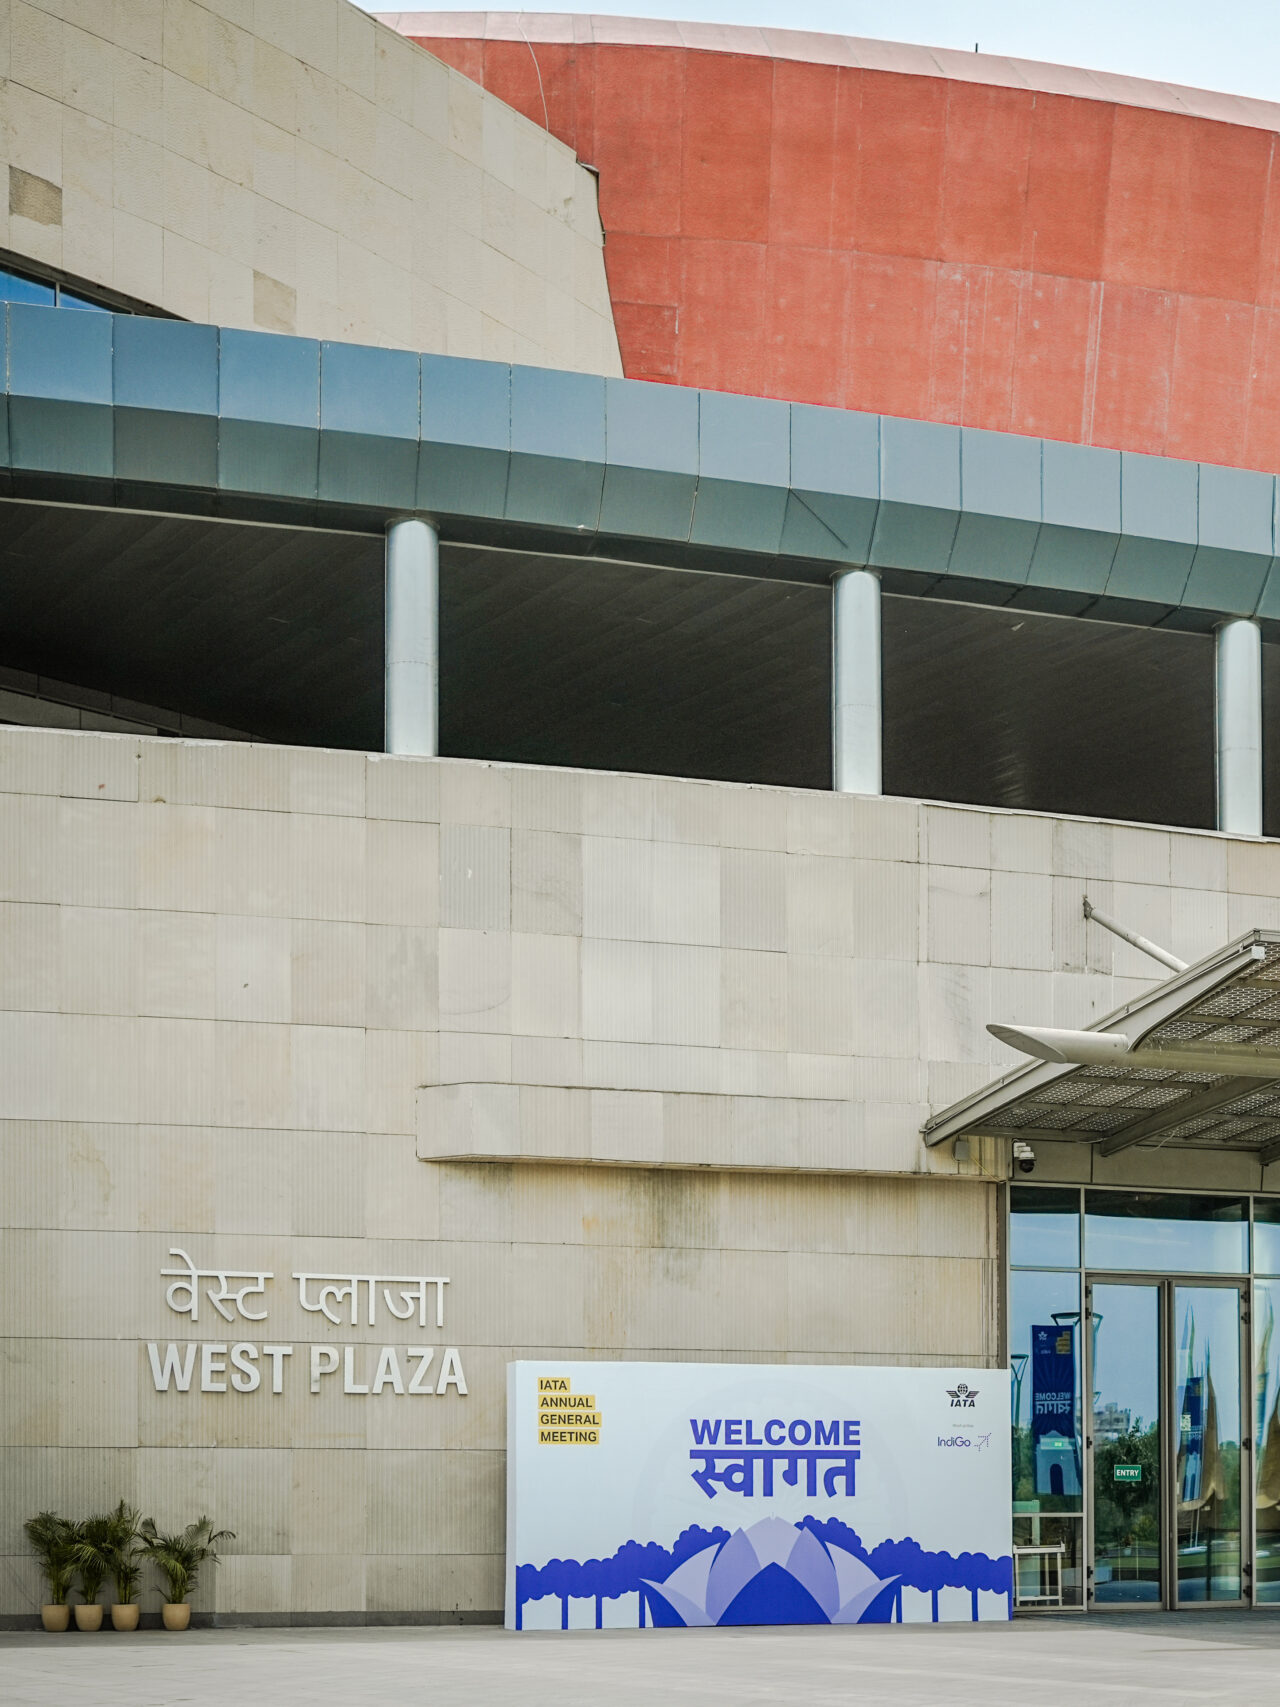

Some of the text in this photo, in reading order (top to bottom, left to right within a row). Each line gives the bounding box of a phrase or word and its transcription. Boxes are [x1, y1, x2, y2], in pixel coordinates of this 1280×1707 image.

[160, 1248, 451, 1328] वेस्ट प्लाजा
[147, 1342, 469, 1396] WEST PLAZA
[539, 1379, 568, 1391] IATA
[540, 1397, 593, 1408] ANNUAL
[950, 1398, 976, 1408] IATA
[540, 1414, 600, 1425] GENERAL
[540, 1431, 597, 1442] MEETING
[689, 1418, 862, 1446] WELCOME
[937, 1435, 971, 1448] IndiGo
[689, 1449, 862, 1500] स्वागत
[1116, 1468, 1140, 1477] ENTRY
